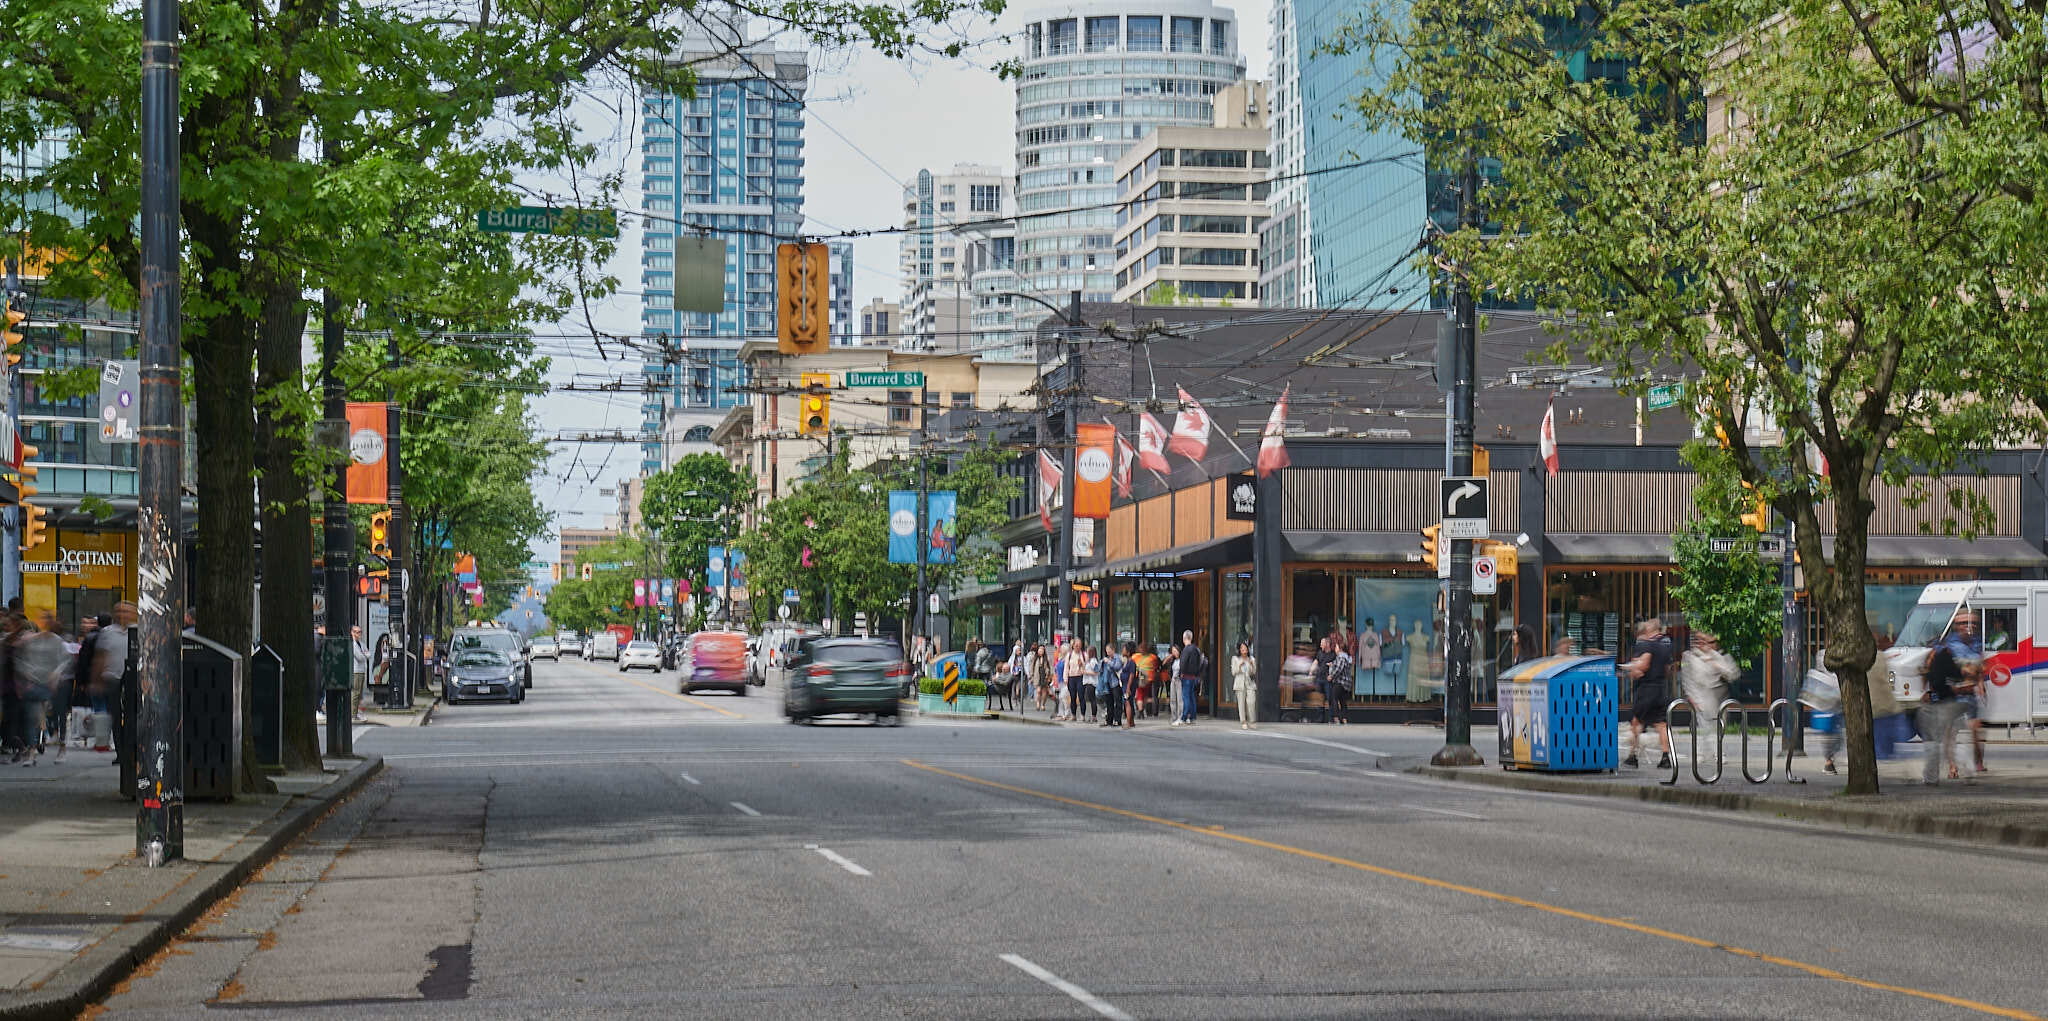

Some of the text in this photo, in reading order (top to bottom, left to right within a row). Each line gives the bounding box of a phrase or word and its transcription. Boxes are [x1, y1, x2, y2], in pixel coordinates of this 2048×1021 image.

[850, 372, 919, 385] Burrard St
[23, 563, 58, 572] Burrard
[1138, 579, 1184, 591] Roots
